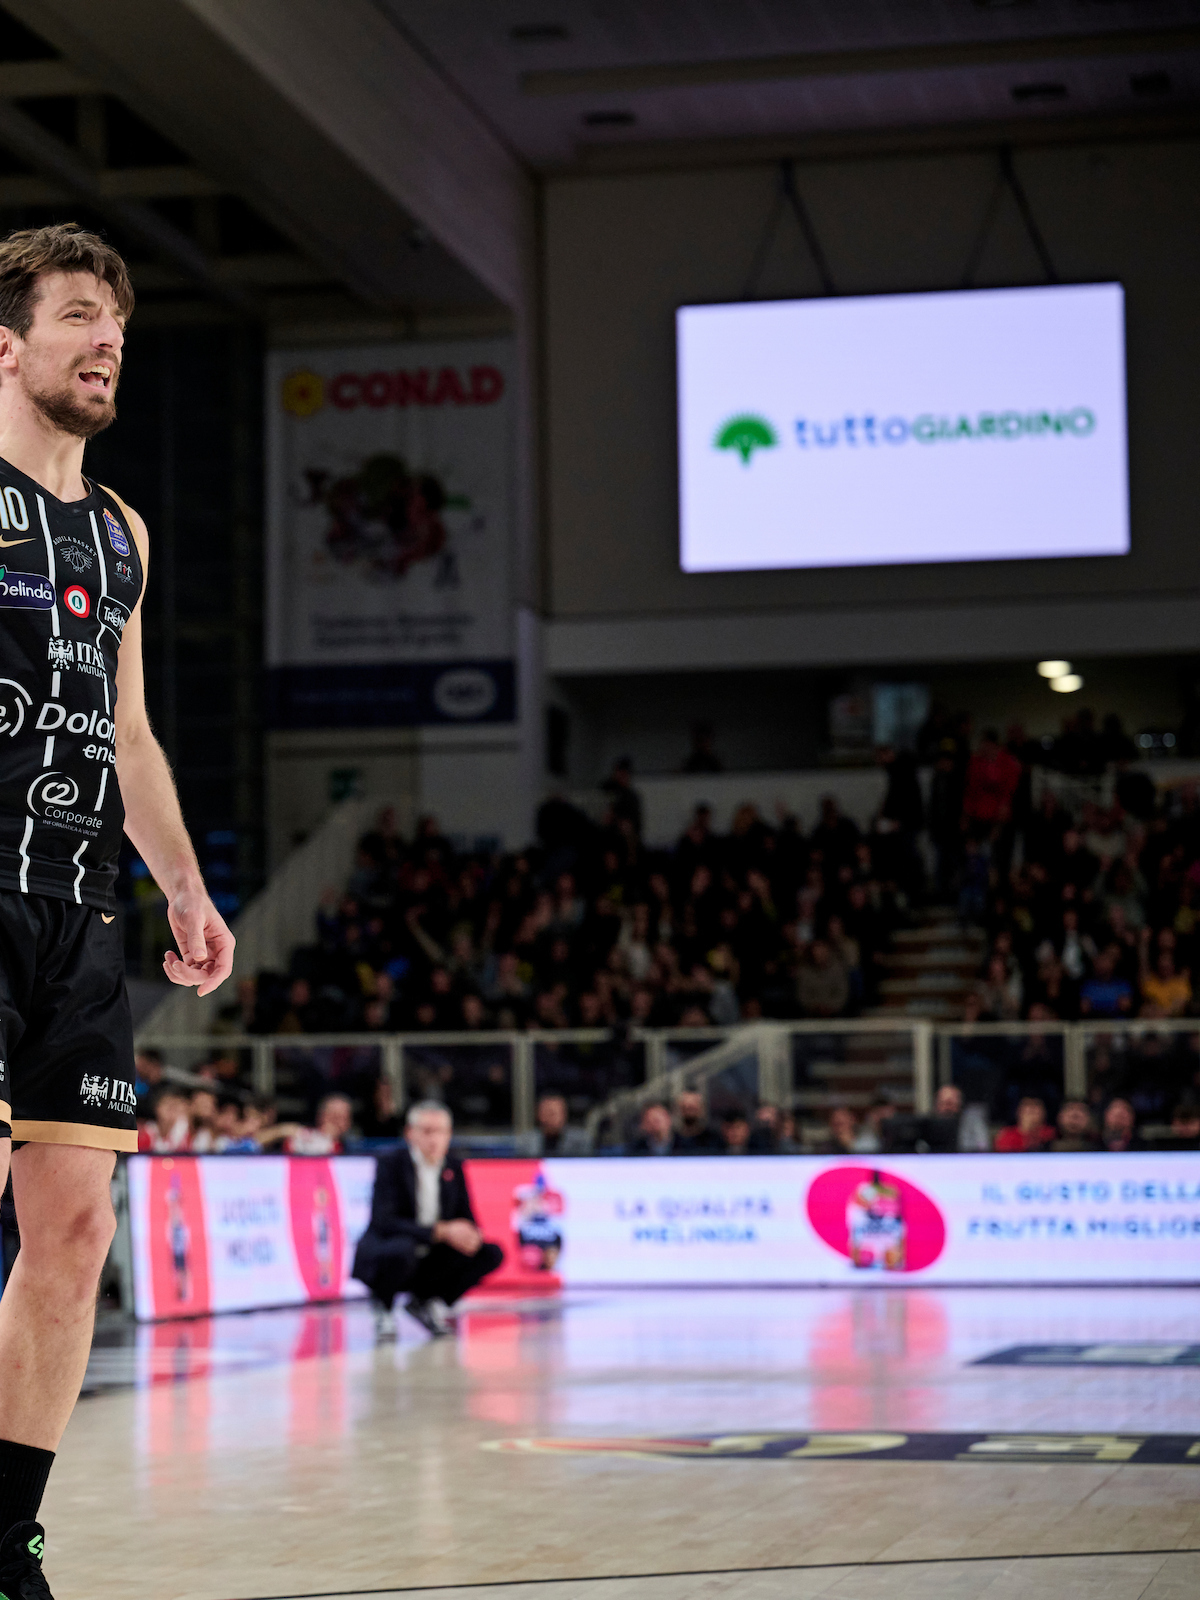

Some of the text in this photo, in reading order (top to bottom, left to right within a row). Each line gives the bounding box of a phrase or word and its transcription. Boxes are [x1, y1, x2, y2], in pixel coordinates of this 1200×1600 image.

[329, 365, 504, 408] CONAD
[794, 405, 1096, 450] tuttoGIARDINO
[72, 537, 97, 557] BASKET
[42, 819, 78, 833] INFORMATICA
[83, 828, 99, 838] VALORE
[44, 805, 104, 829] Corporate
[981, 1181, 1004, 1204] IL
[1016, 1180, 1110, 1205] GUSTO
[632, 1224, 757, 1246] MELINDA
[967, 1215, 1076, 1241] FRUTTA
